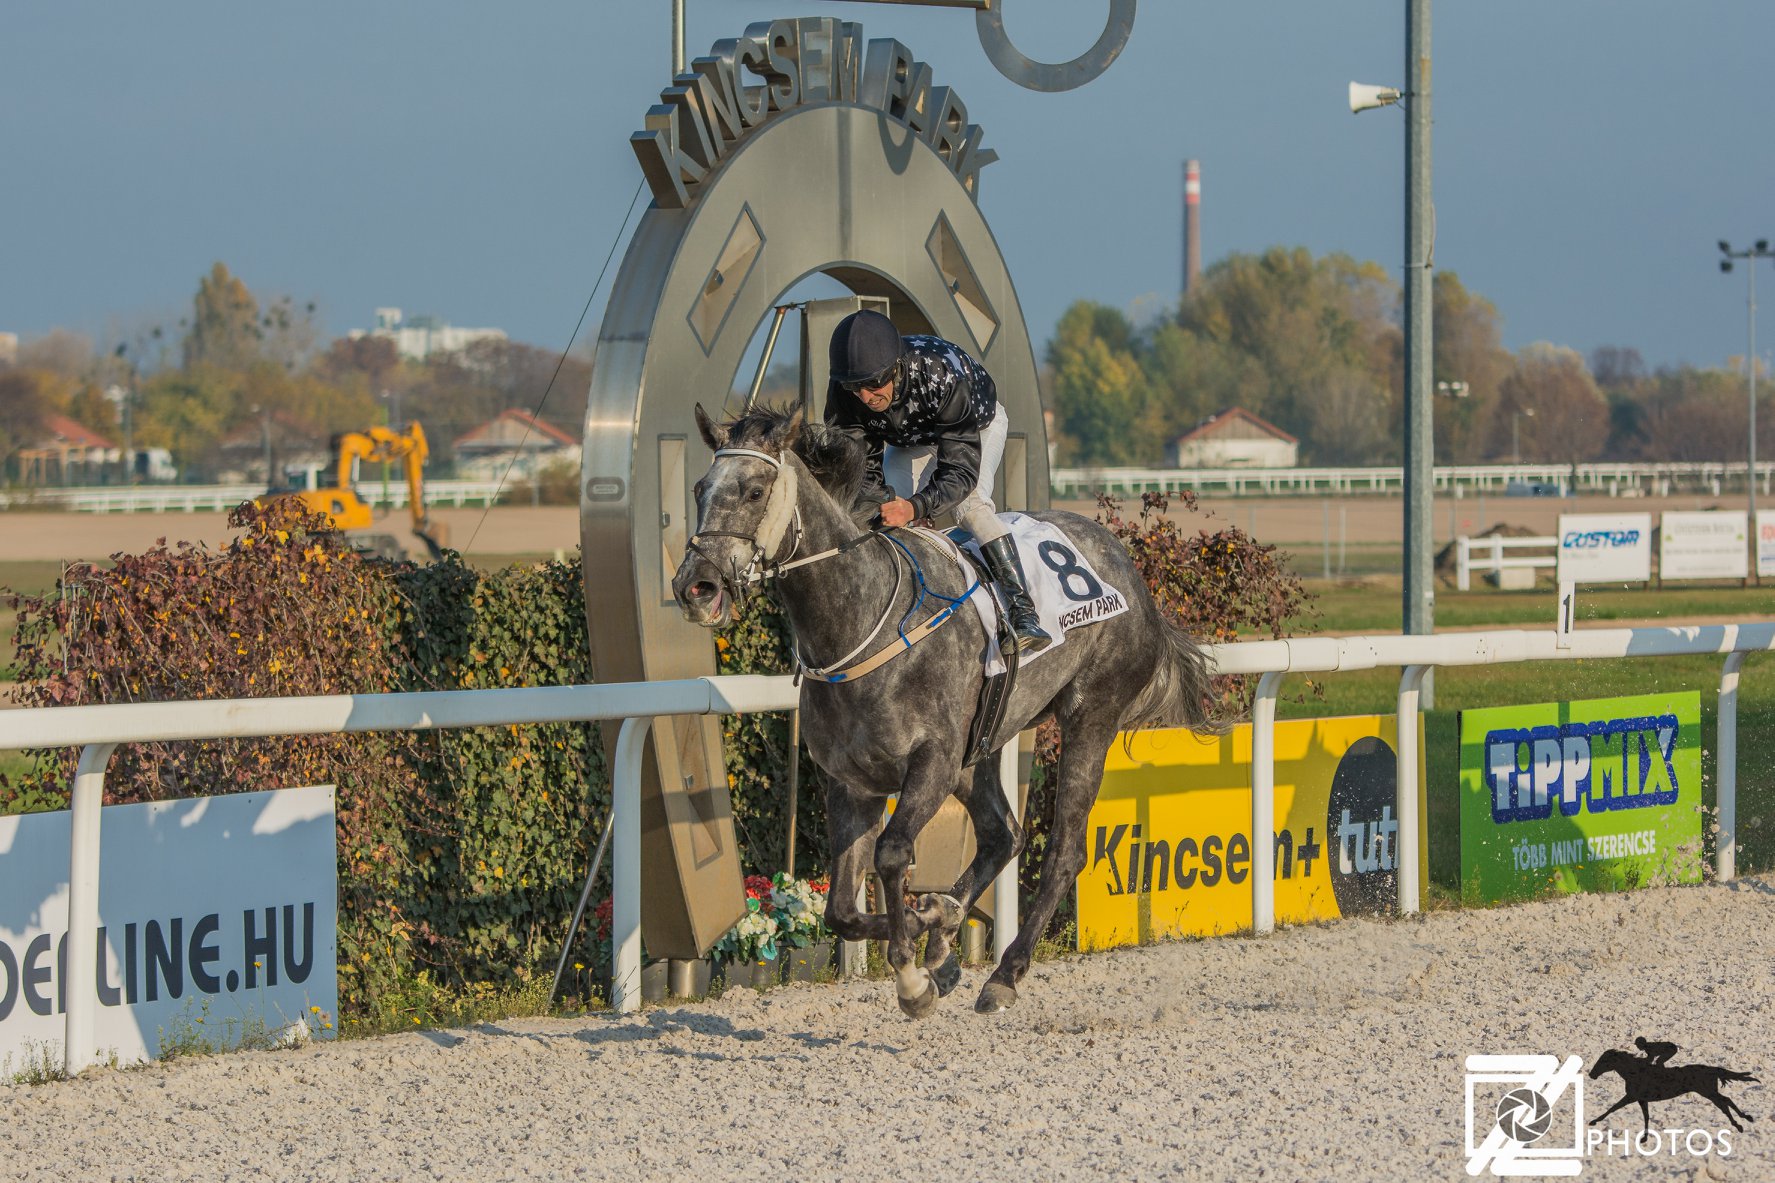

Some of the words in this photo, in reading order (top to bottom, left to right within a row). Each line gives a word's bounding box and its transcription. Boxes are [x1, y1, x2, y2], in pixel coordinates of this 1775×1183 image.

[631, 17, 863, 208] KINCSEM
[862, 38, 1000, 206] PARK
[1563, 529, 1640, 548] CUSTOM
[1038, 540, 1103, 601] 8
[1096, 593, 1123, 617] PARK
[1562, 593, 1571, 634] 1
[1337, 805, 1398, 875] tut
[1512, 838, 1548, 871] TÖBB
[1551, 839, 1584, 867] MINT
[1587, 830, 1656, 861] SZERENCSE
